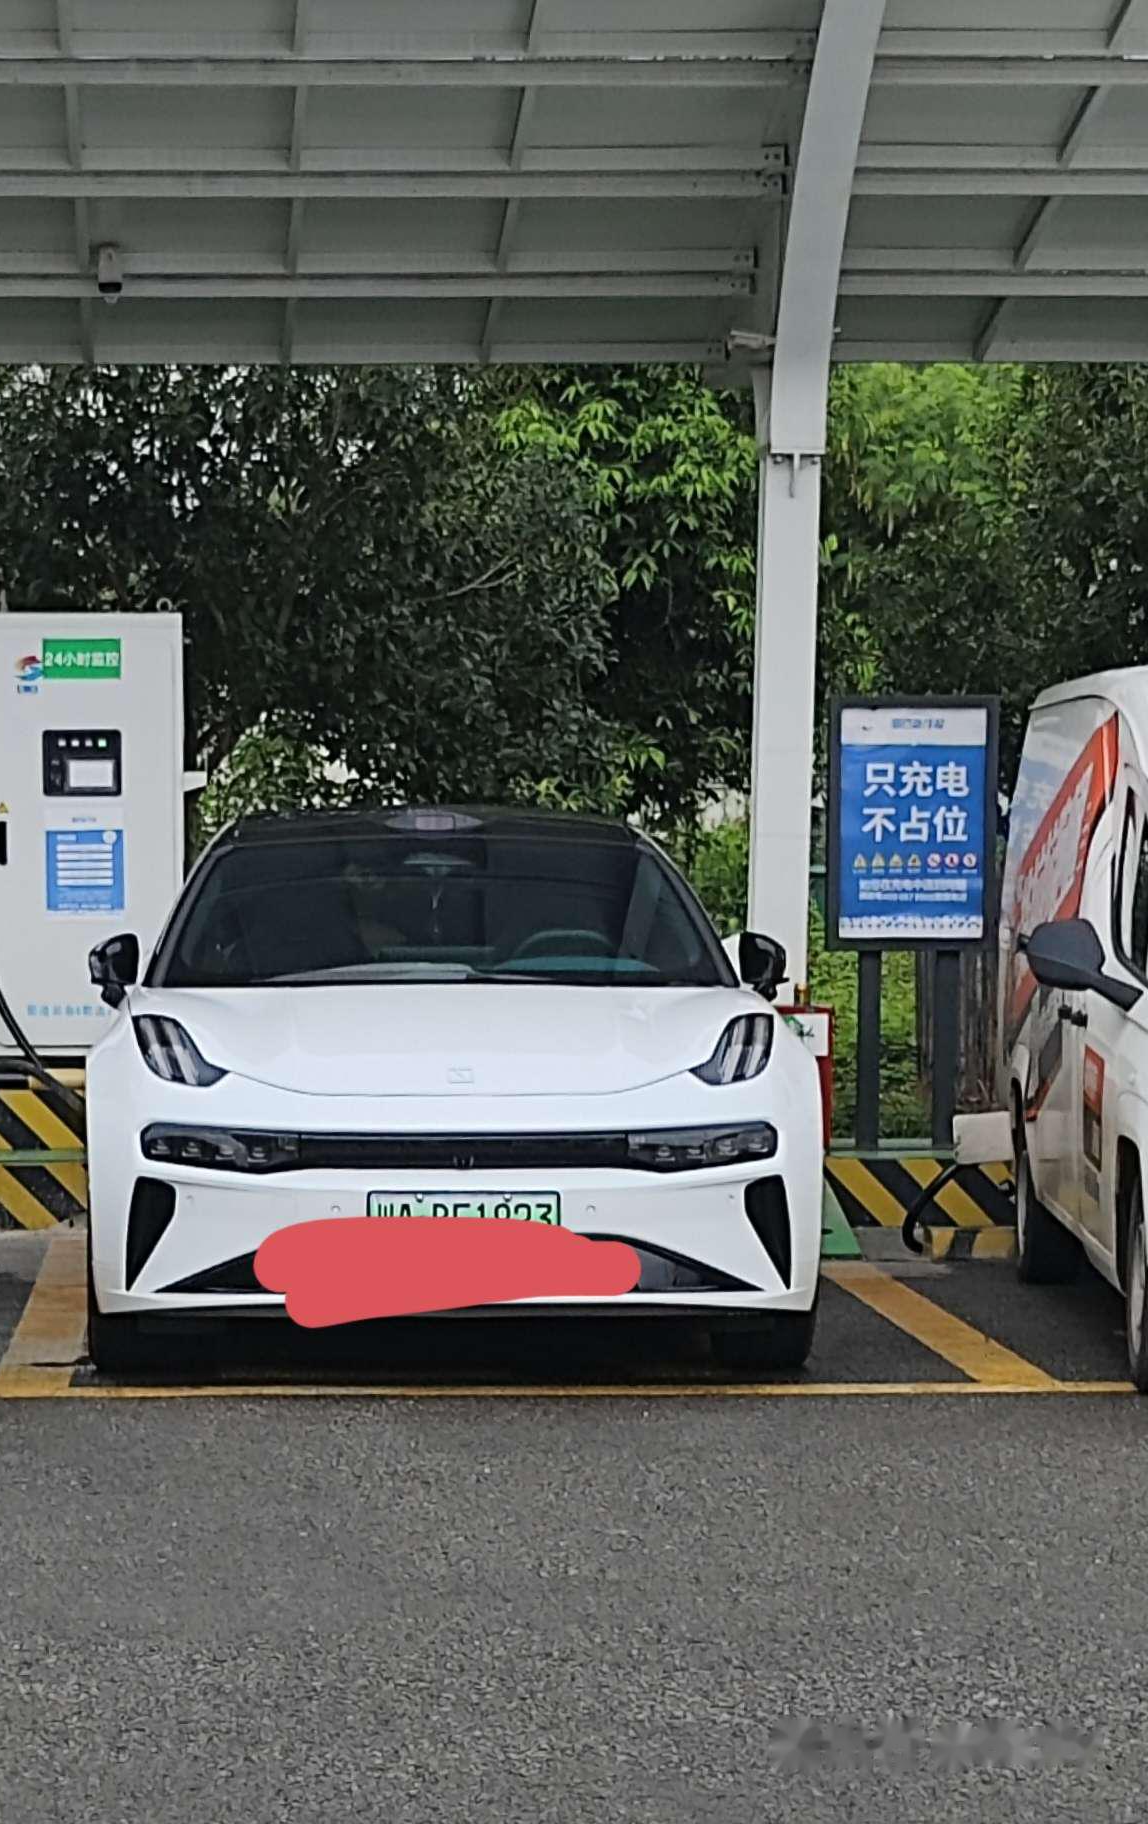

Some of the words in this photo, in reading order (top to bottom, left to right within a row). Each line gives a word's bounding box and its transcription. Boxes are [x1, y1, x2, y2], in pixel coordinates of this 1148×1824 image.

[862, 760, 970, 798] 只充电
[861, 805, 969, 843] 不占位
